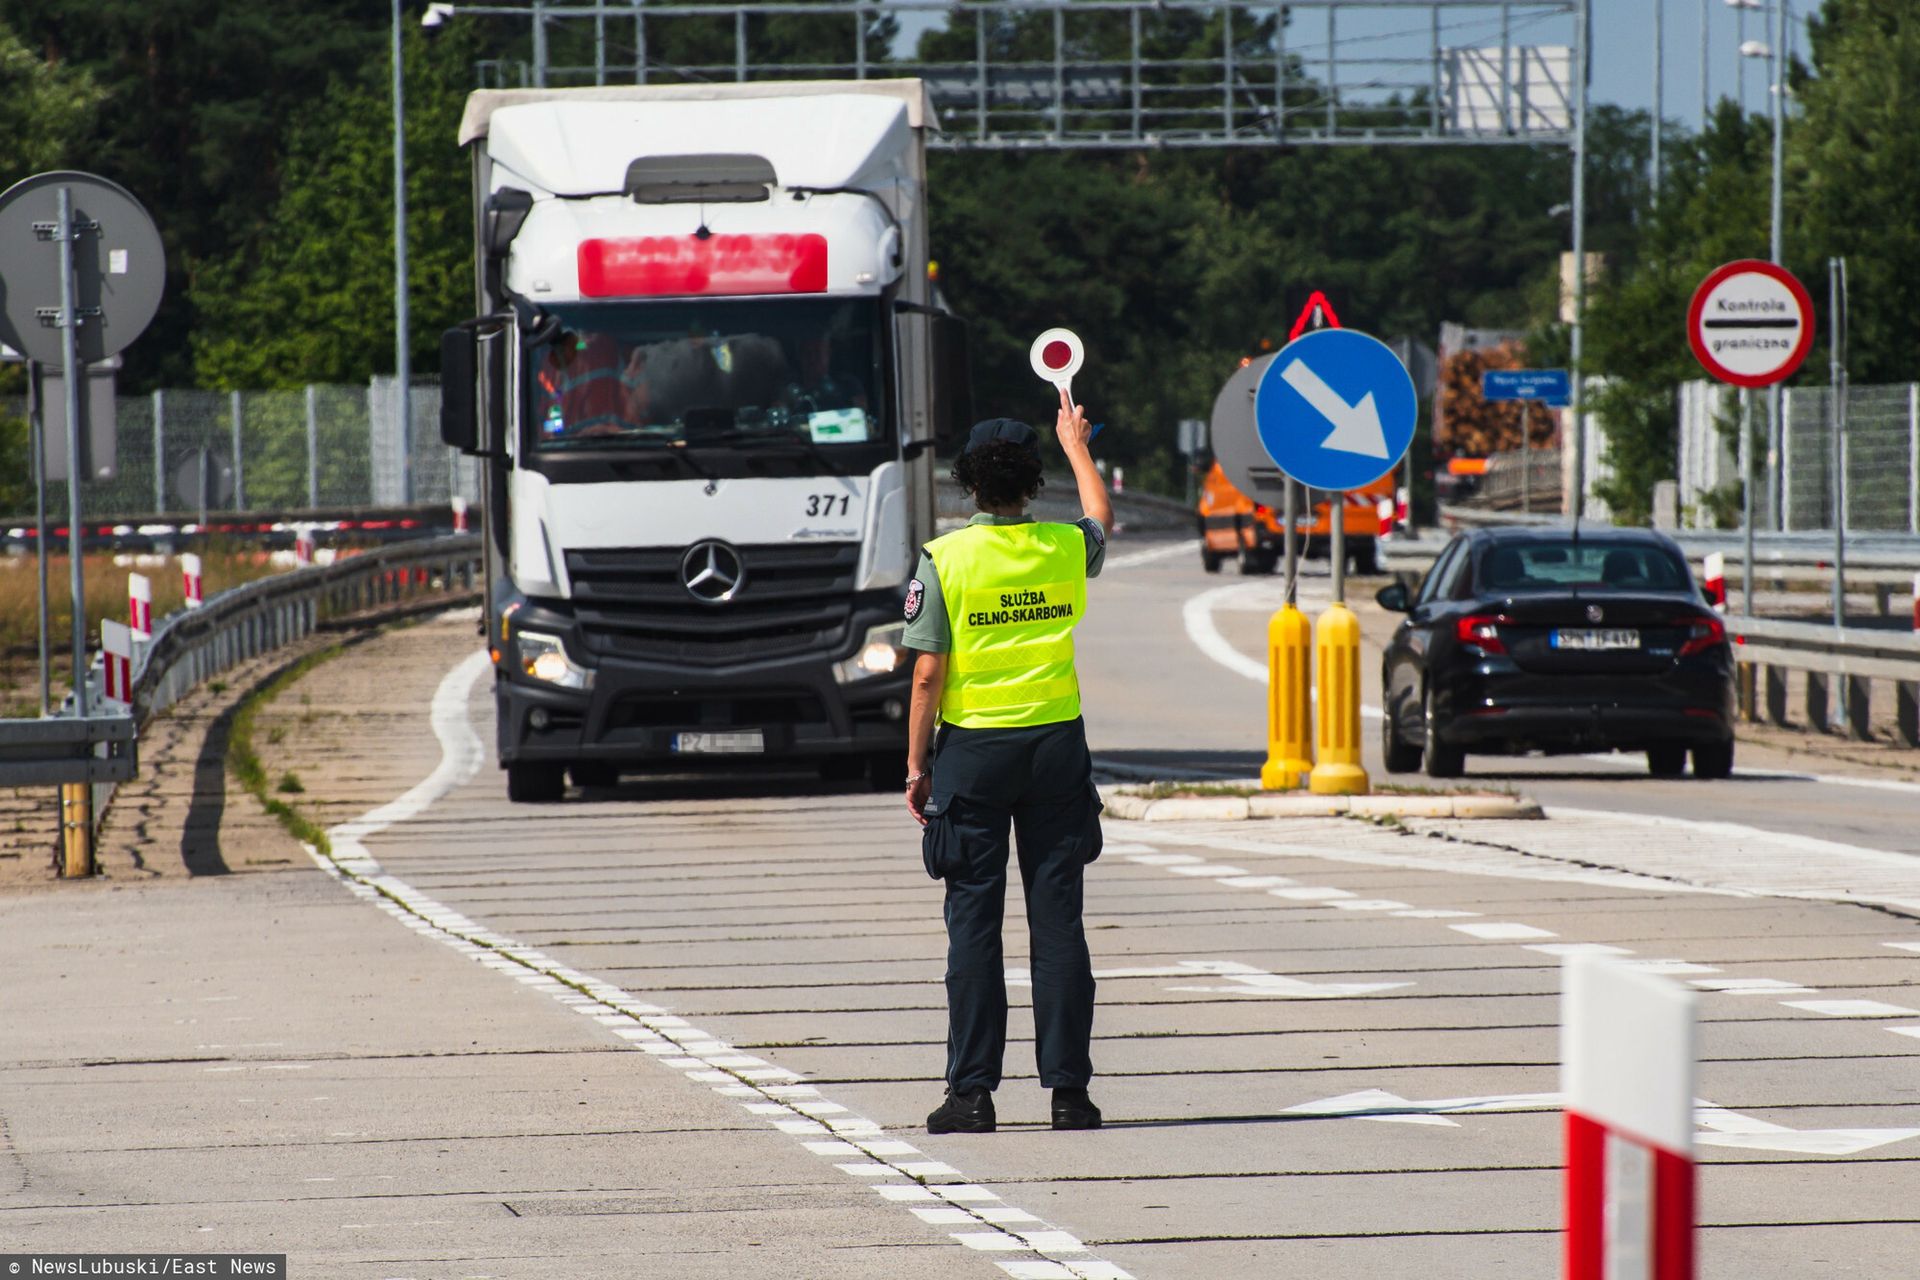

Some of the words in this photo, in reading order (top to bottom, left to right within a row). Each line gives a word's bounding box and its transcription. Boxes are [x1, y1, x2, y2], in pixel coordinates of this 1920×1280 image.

[1718, 299, 1786, 311] Kontrola
[1713, 337, 1789, 352] graniczna
[806, 494, 849, 516] 371
[1000, 589, 1046, 607] SŁUŻBA
[968, 603, 1073, 626] CELNO-SKARBOWA
